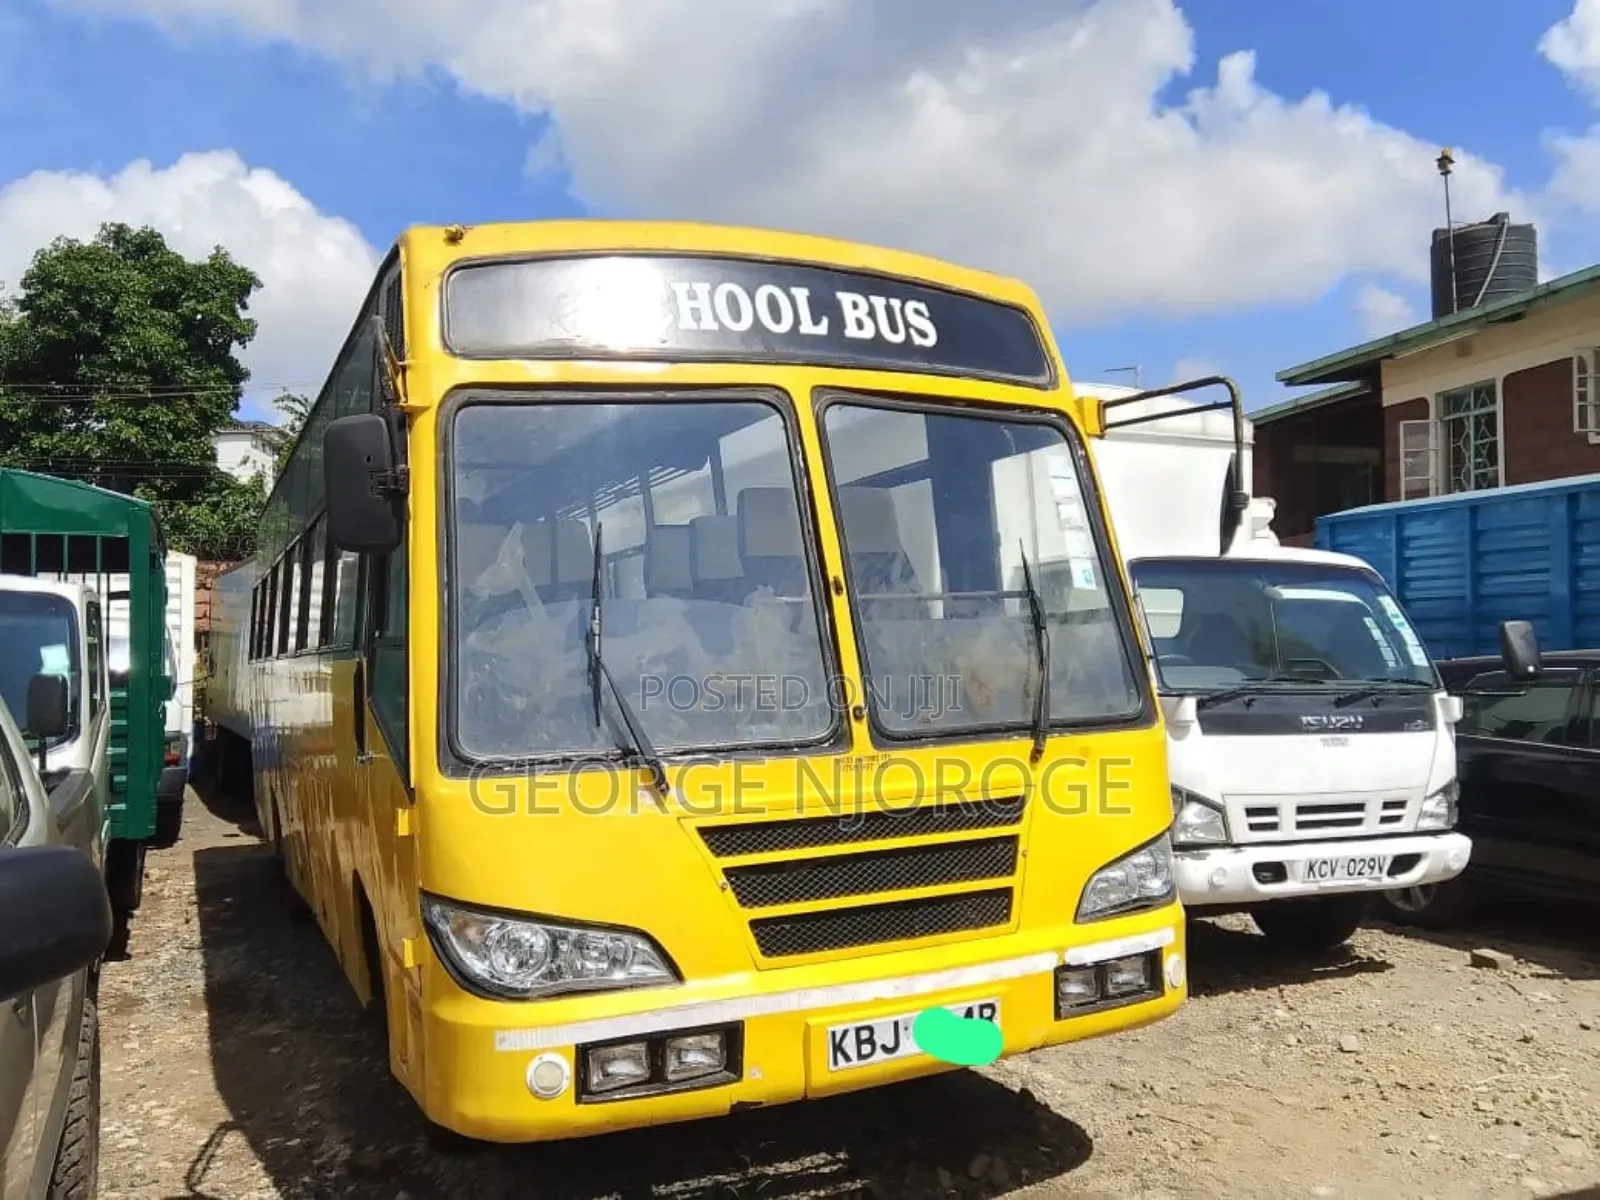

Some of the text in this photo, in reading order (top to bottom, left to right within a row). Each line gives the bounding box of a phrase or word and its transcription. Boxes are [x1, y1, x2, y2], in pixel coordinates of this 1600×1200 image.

[660, 281, 938, 347] HOOL BUS
[1307, 857, 1386, 879] KCV 029V
[831, 1020, 900, 1066] KBJ
